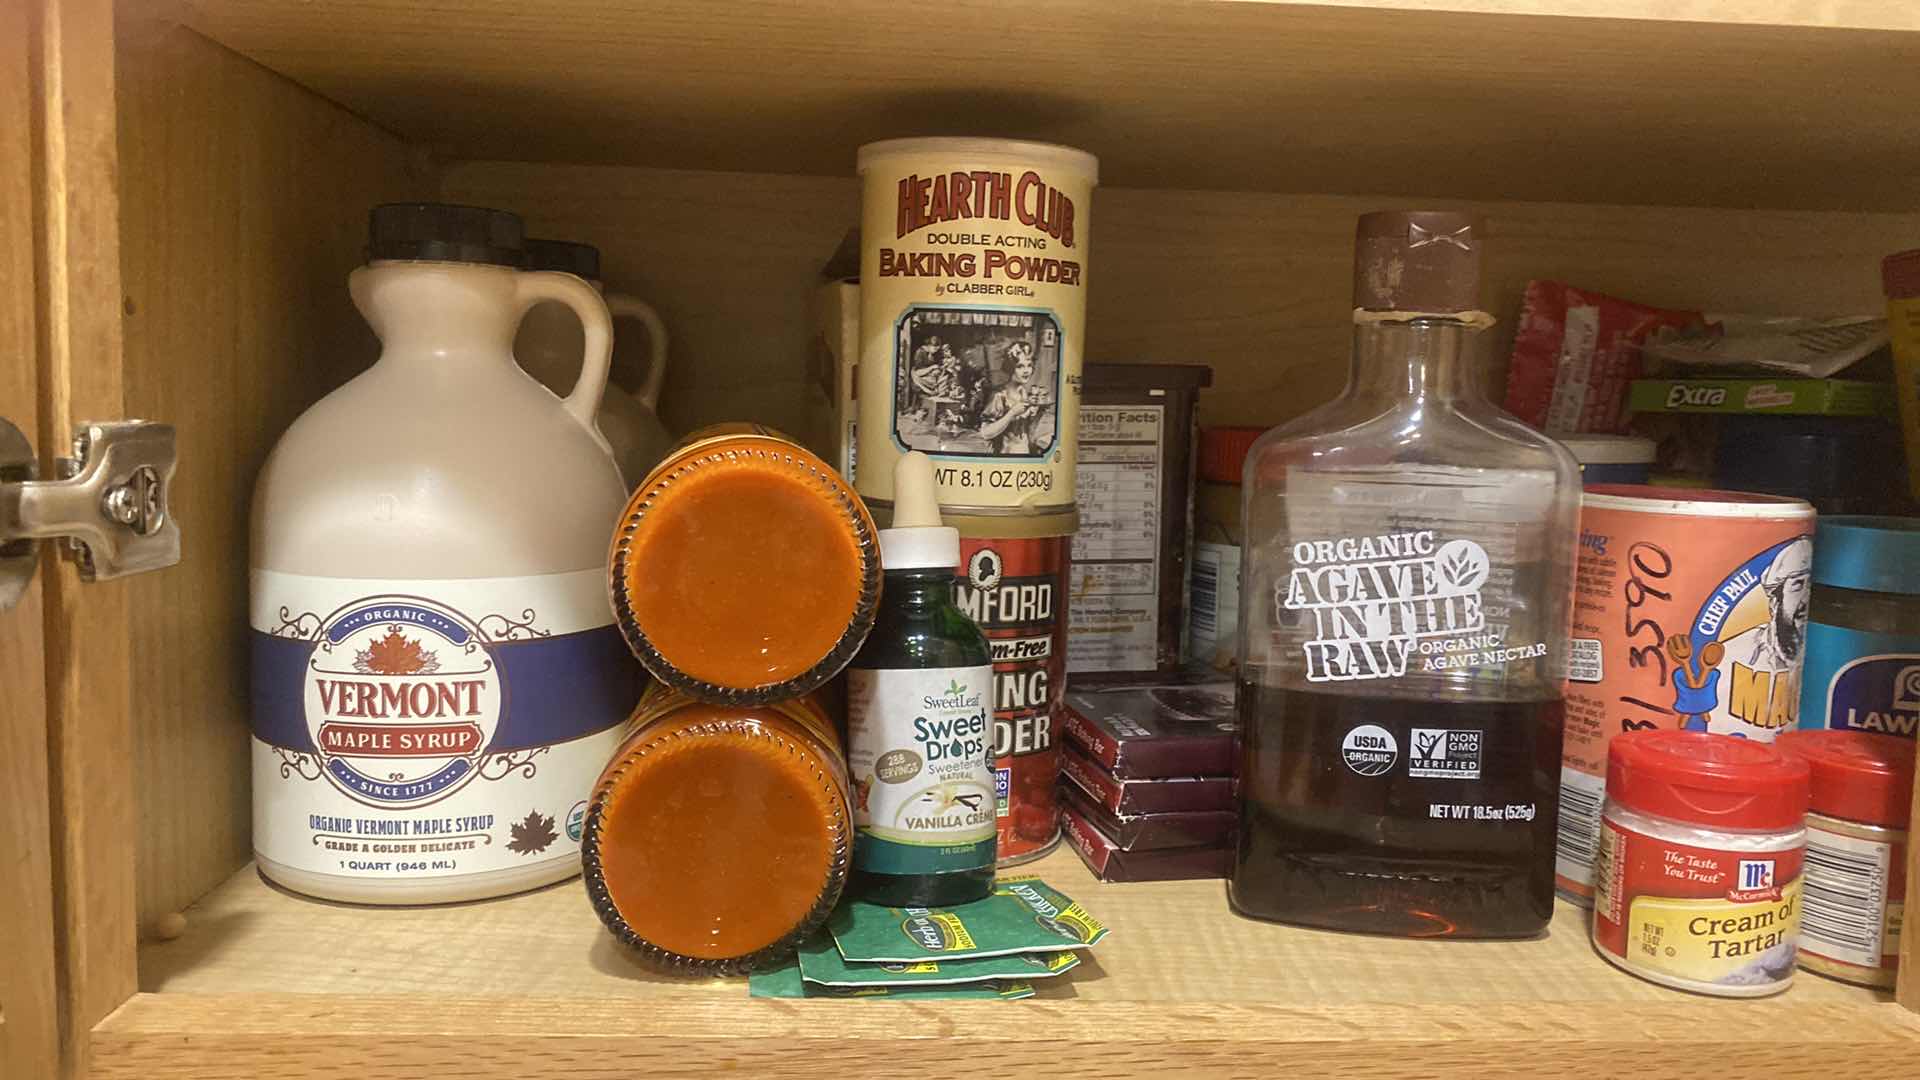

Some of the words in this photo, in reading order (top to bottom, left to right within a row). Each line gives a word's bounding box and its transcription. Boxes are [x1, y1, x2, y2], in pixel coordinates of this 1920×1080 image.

[897, 171, 1012, 240] HEARTH
[1015, 170, 1075, 247] CLUB
[928, 233, 991, 246] DOUBLE
[994, 235, 1046, 250] ACTING
[879, 248, 977, 279] BAKING
[984, 249, 1081, 287] POWDER
[935, 285, 945, 296] by
[946, 283, 1003, 295] CLABBER
[1005, 286, 1034, 297] GIRL
[1666, 385, 1727, 408] Extra
[1119, 412, 1157, 423] Facts
[961, 470, 983, 487] 8.1
[989, 471, 1013, 488] OZ
[1016, 470, 1053, 491] (230g)
[1293, 531, 1434, 565] ORGANIC
[1583, 528, 1608, 556] ing
[1285, 558, 1440, 609] AGAVE
[957, 584, 1051, 622] MFORD
[1699, 597, 1729, 635] CHEF
[1722, 568, 1757, 602] PAUL
[364, 609, 426, 622] ORGANIC
[1316, 604, 1368, 640] IN
[1378, 593, 1484, 636] THE
[1624, 541, 1673, 687] 3590
[992, 641, 1046, 658] m-Free
[1420, 634, 1500, 655] ORGANIC
[1304, 639, 1410, 681] RAW
[1423, 653, 1479, 671] AGAVE
[1481, 643, 1547, 664] NECTAR
[315, 679, 486, 719] VERMONT
[993, 671, 1048, 707] ING
[1729, 661, 1798, 729] MA
[923, 695, 980, 710] SweetLeaf
[914, 707, 986, 742] Sweet
[1847, 708, 1918, 734] LAW
[328, 731, 392, 749] MAPLE
[400, 731, 471, 749] SYRUP
[994, 716, 1050, 755] DER
[1354, 736, 1387, 749] USDA
[1449, 733, 1478, 742] NON
[926, 738, 983, 761] Drops
[1349, 751, 1391, 763] ORGANIC
[1448, 742, 1478, 751] GMO
[1414, 760, 1477, 769] VERIFIED
[940, 771, 974, 780] NATURAL
[360, 781, 399, 796] SINCE
[405, 782, 433, 797] 1777
[905, 815, 963, 830] VANILLA
[1430, 804, 1450, 818] NET
[1451, 805, 1471, 819] WT
[1473, 806, 1504, 819] 18.5oz
[1505, 803, 1536, 821] (525g)
[309, 814, 352, 833] ORGANIC
[356, 819, 409, 835] VERMONT
[413, 818, 450, 834] MAPLE
[455, 814, 494, 833] SYRUP
[325, 840, 358, 852] GRADE
[362, 844, 370, 853] A
[373, 844, 417, 853] GOLDEN
[421, 840, 476, 853] DELICATE
[340, 860, 345, 868] 1
[349, 860, 391, 871] QUART
[396, 861, 427, 872] (946
[432, 859, 457, 870] ML)
[1664, 850, 1685, 864] The
[1686, 855, 1718, 870] Taste
[1664, 864, 1685, 879] You
[1728, 887, 1780, 900] McCormick
[1688, 911, 1774, 936] Cream
[1779, 895, 1794, 920] of
[1708, 928, 1785, 959] Tartar
